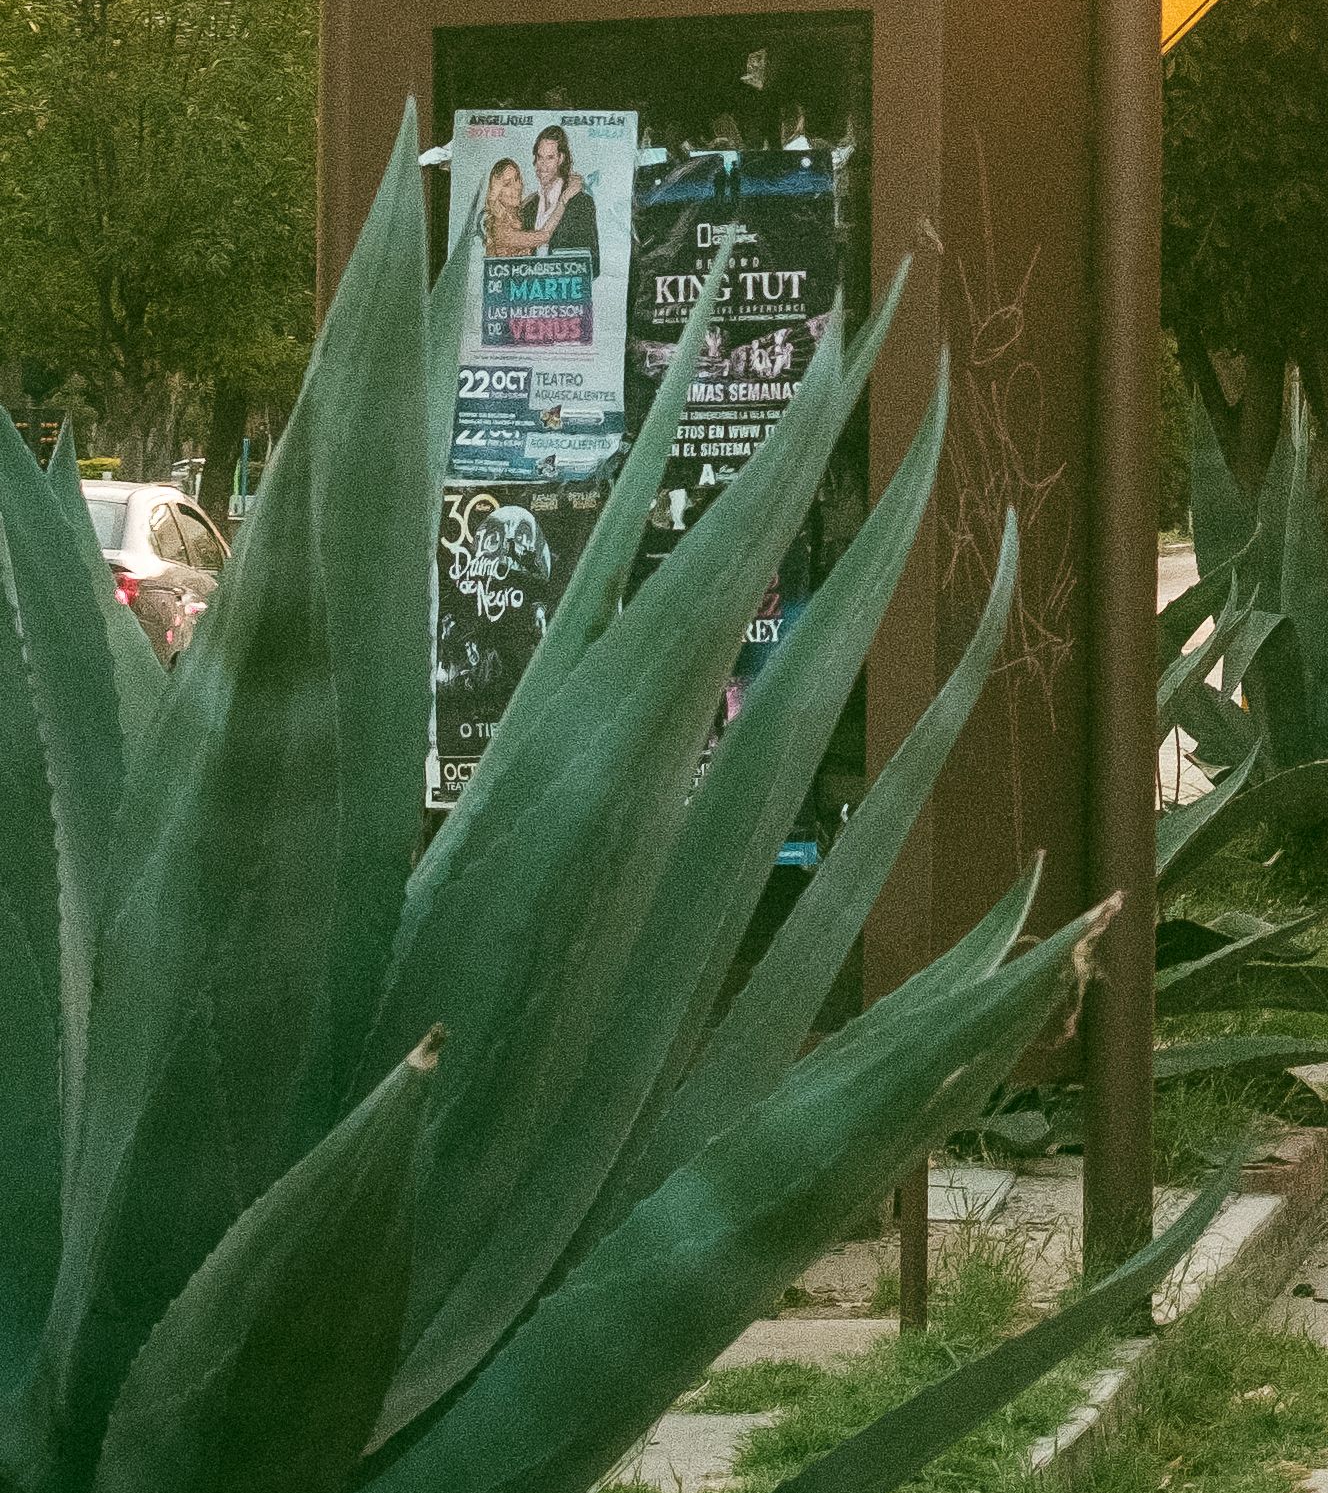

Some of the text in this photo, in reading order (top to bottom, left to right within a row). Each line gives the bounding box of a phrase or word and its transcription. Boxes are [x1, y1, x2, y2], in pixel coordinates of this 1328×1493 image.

[469, 115, 534, 126] ANGELIQUE
[488, 262, 588, 277] LOS HOMBRES SON
[696, 257, 760, 270] BEOND
[509, 277, 583, 301] MARTE
[739, 271, 807, 300] TUT
[488, 304, 584, 320] LAS MUJERES SON
[509, 318, 582, 341] VENUS
[458, 369, 528, 399] 22 OCT
[536, 373, 584, 387] TEATRO
[535, 390, 616, 405] AGUASCALIENTES
[687, 383, 724, 402] IMAS
[676, 425, 705, 439] ETOS
[708, 425, 725, 439] EN
[683, 443, 697, 457] EL
[700, 442, 751, 457] SISTEMA
[476, 576, 524, 622] Negro
[460, 722, 472, 738] O
